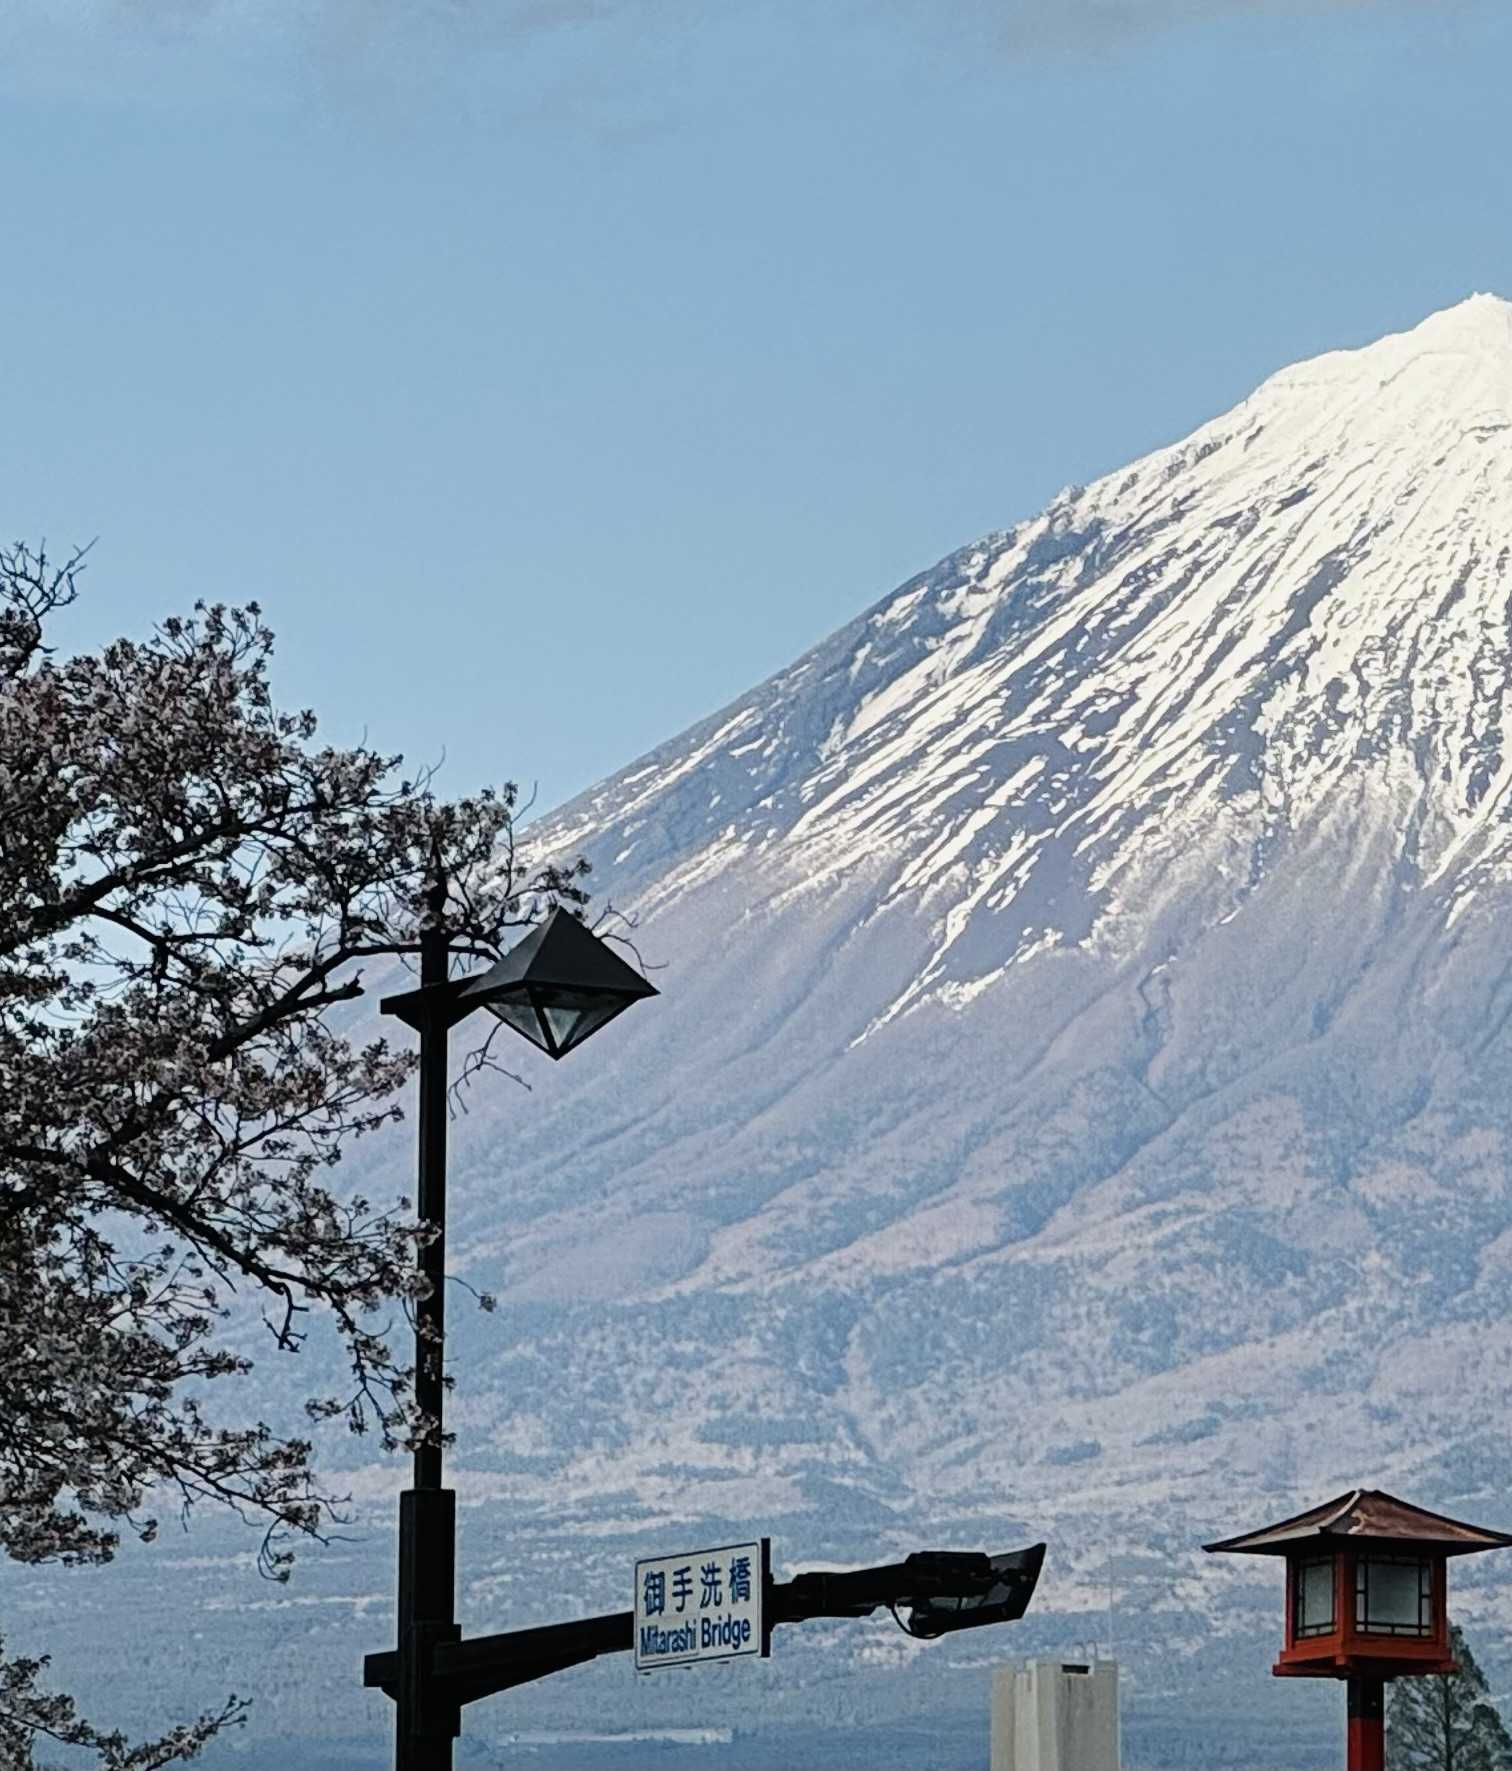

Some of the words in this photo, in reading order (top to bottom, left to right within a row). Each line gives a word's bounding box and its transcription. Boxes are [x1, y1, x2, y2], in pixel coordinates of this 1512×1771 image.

[643, 1557, 751, 1616] 御手洗橋
[640, 1619, 697, 1656] Mitarashi
[701, 1613, 751, 1650] Bridge
